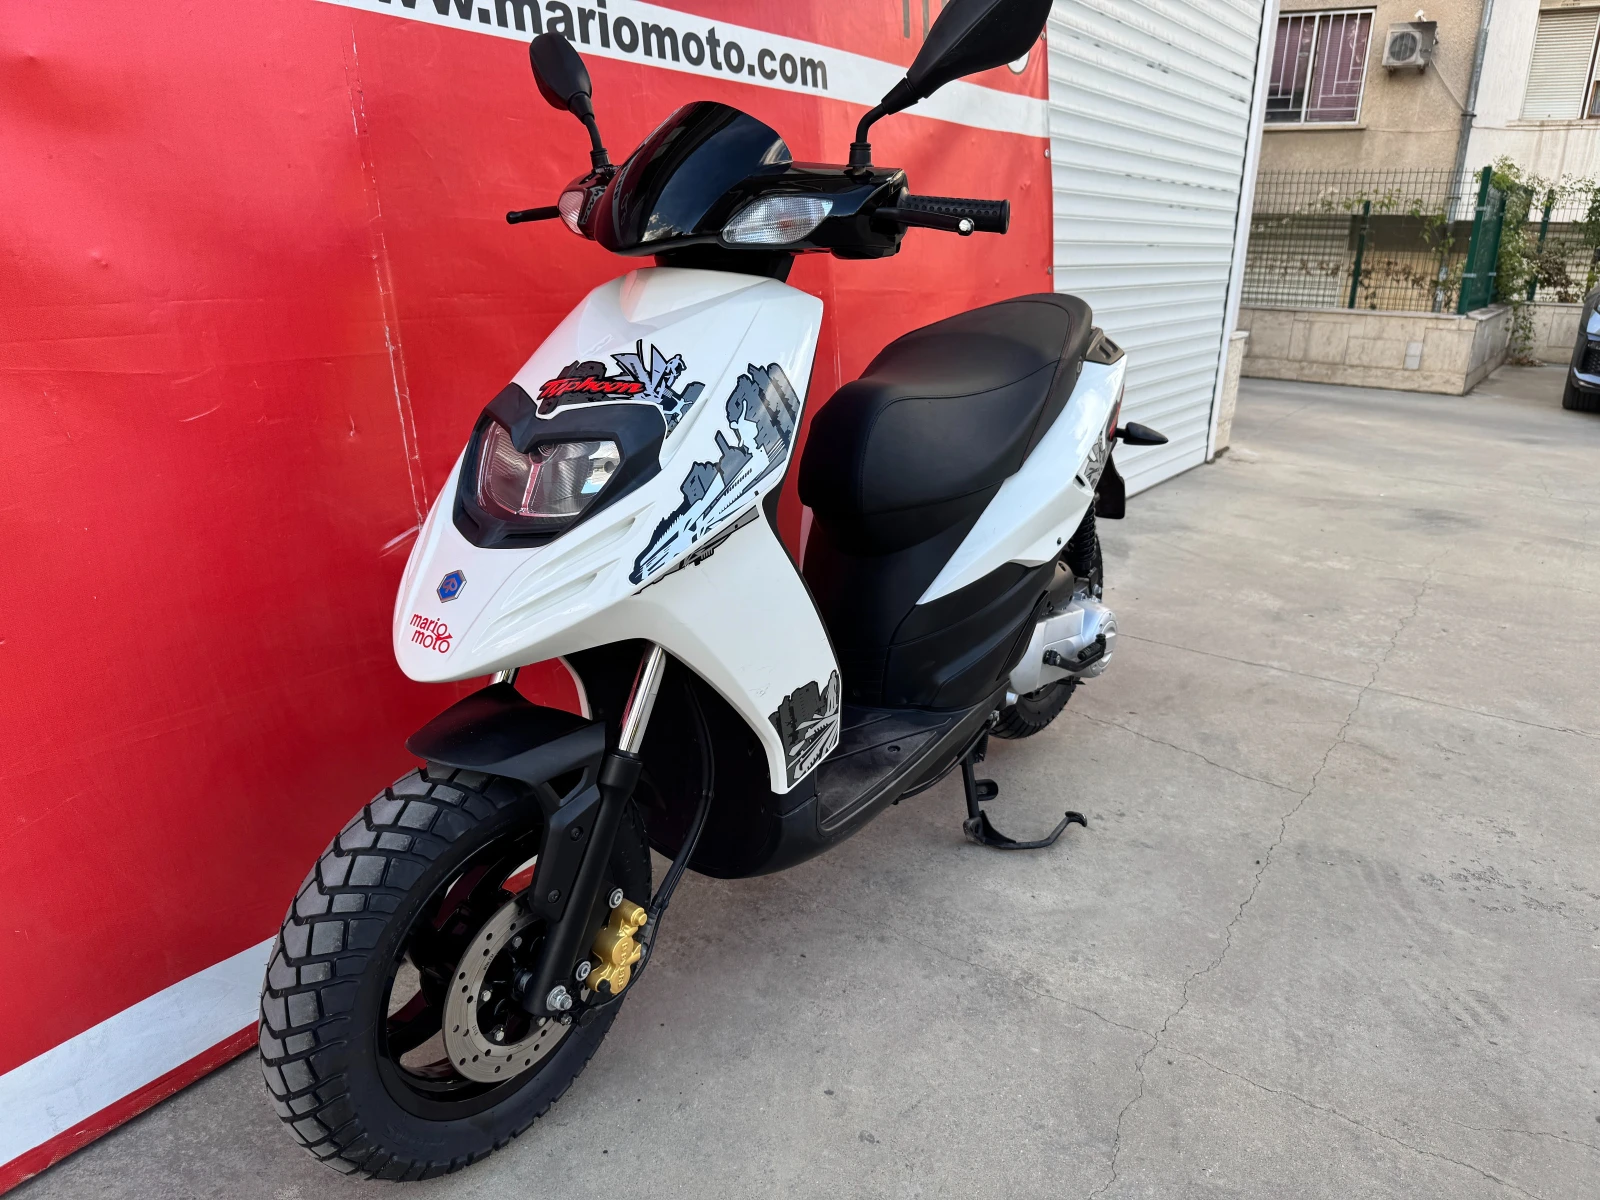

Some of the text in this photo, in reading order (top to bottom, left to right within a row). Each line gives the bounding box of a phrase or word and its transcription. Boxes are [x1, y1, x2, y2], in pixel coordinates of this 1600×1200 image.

[379, 0, 828, 90] .mariomoto.com
[539, 376, 644, 398] Typhoon
[410, 613, 448, 636] mario
[411, 629, 450, 653] moto
